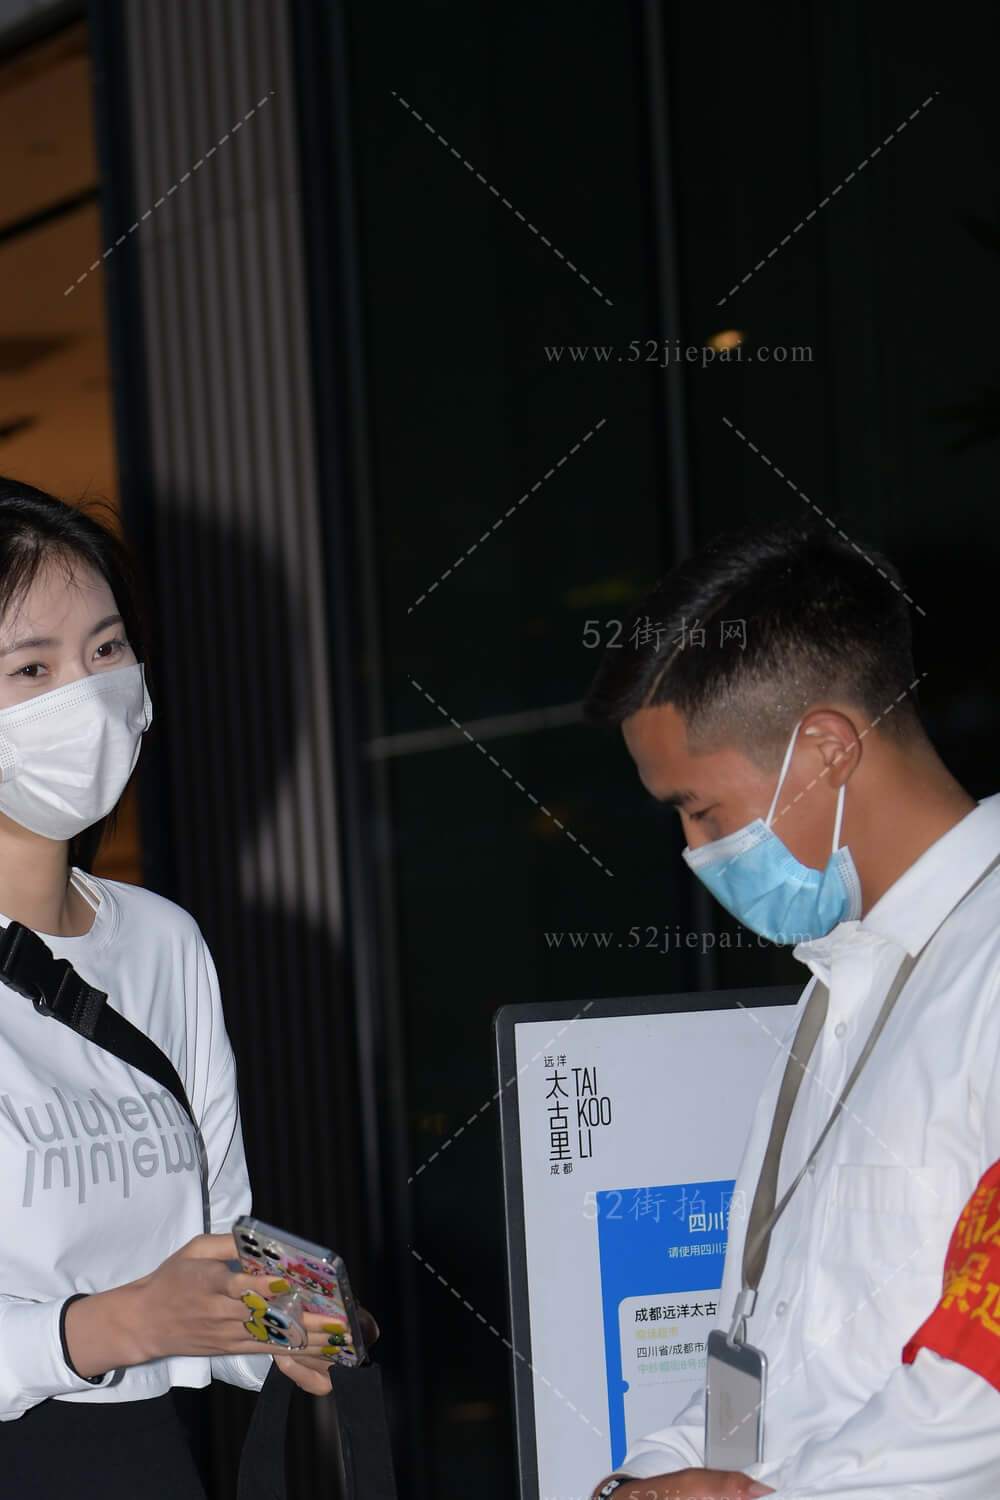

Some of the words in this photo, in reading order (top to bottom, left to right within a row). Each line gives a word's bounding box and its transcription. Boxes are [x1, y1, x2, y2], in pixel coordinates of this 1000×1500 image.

[544, 1055, 568, 1067] 远洋
[571, 1066, 598, 1097] TAI
[545, 1069, 573, 1161] 太古里
[576, 1096, 612, 1128] KOO
[578, 1128, 593, 1158] LI
[550, 1162, 573, 1175] 成都
[689, 1211, 729, 1233] 四川
[635, 1302, 717, 1322] 成都远洋太古
